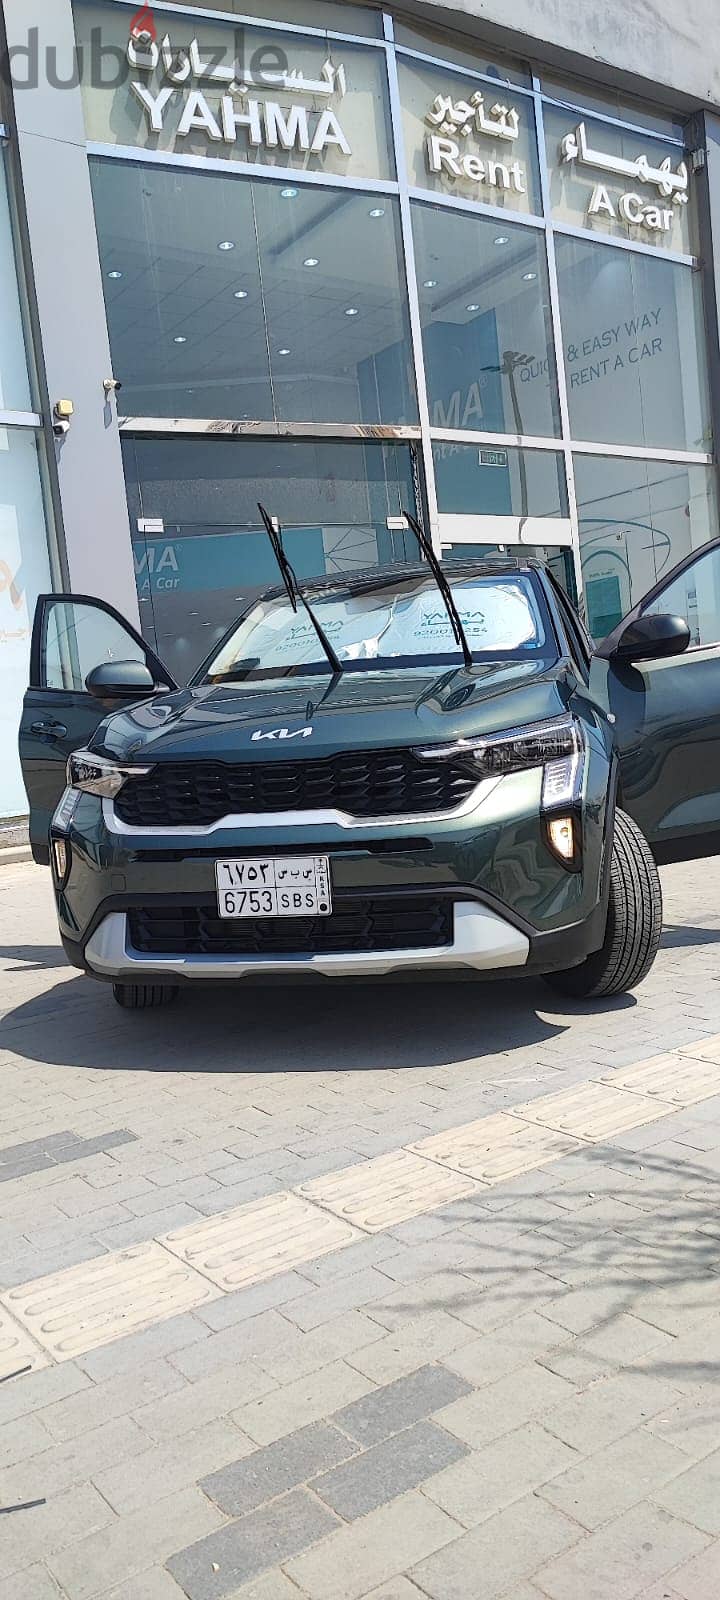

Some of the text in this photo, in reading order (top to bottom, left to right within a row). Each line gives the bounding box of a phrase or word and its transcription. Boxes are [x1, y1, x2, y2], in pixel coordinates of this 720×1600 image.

[130, 81, 674, 231] YAHMA Rent A Car
[582, 326, 621, 356] EASY
[624, 308, 661, 337] WAY
[570, 338, 662, 388] RENT A CAR
[157, 577, 180, 589] Car
[225, 891, 273, 913] 6753
